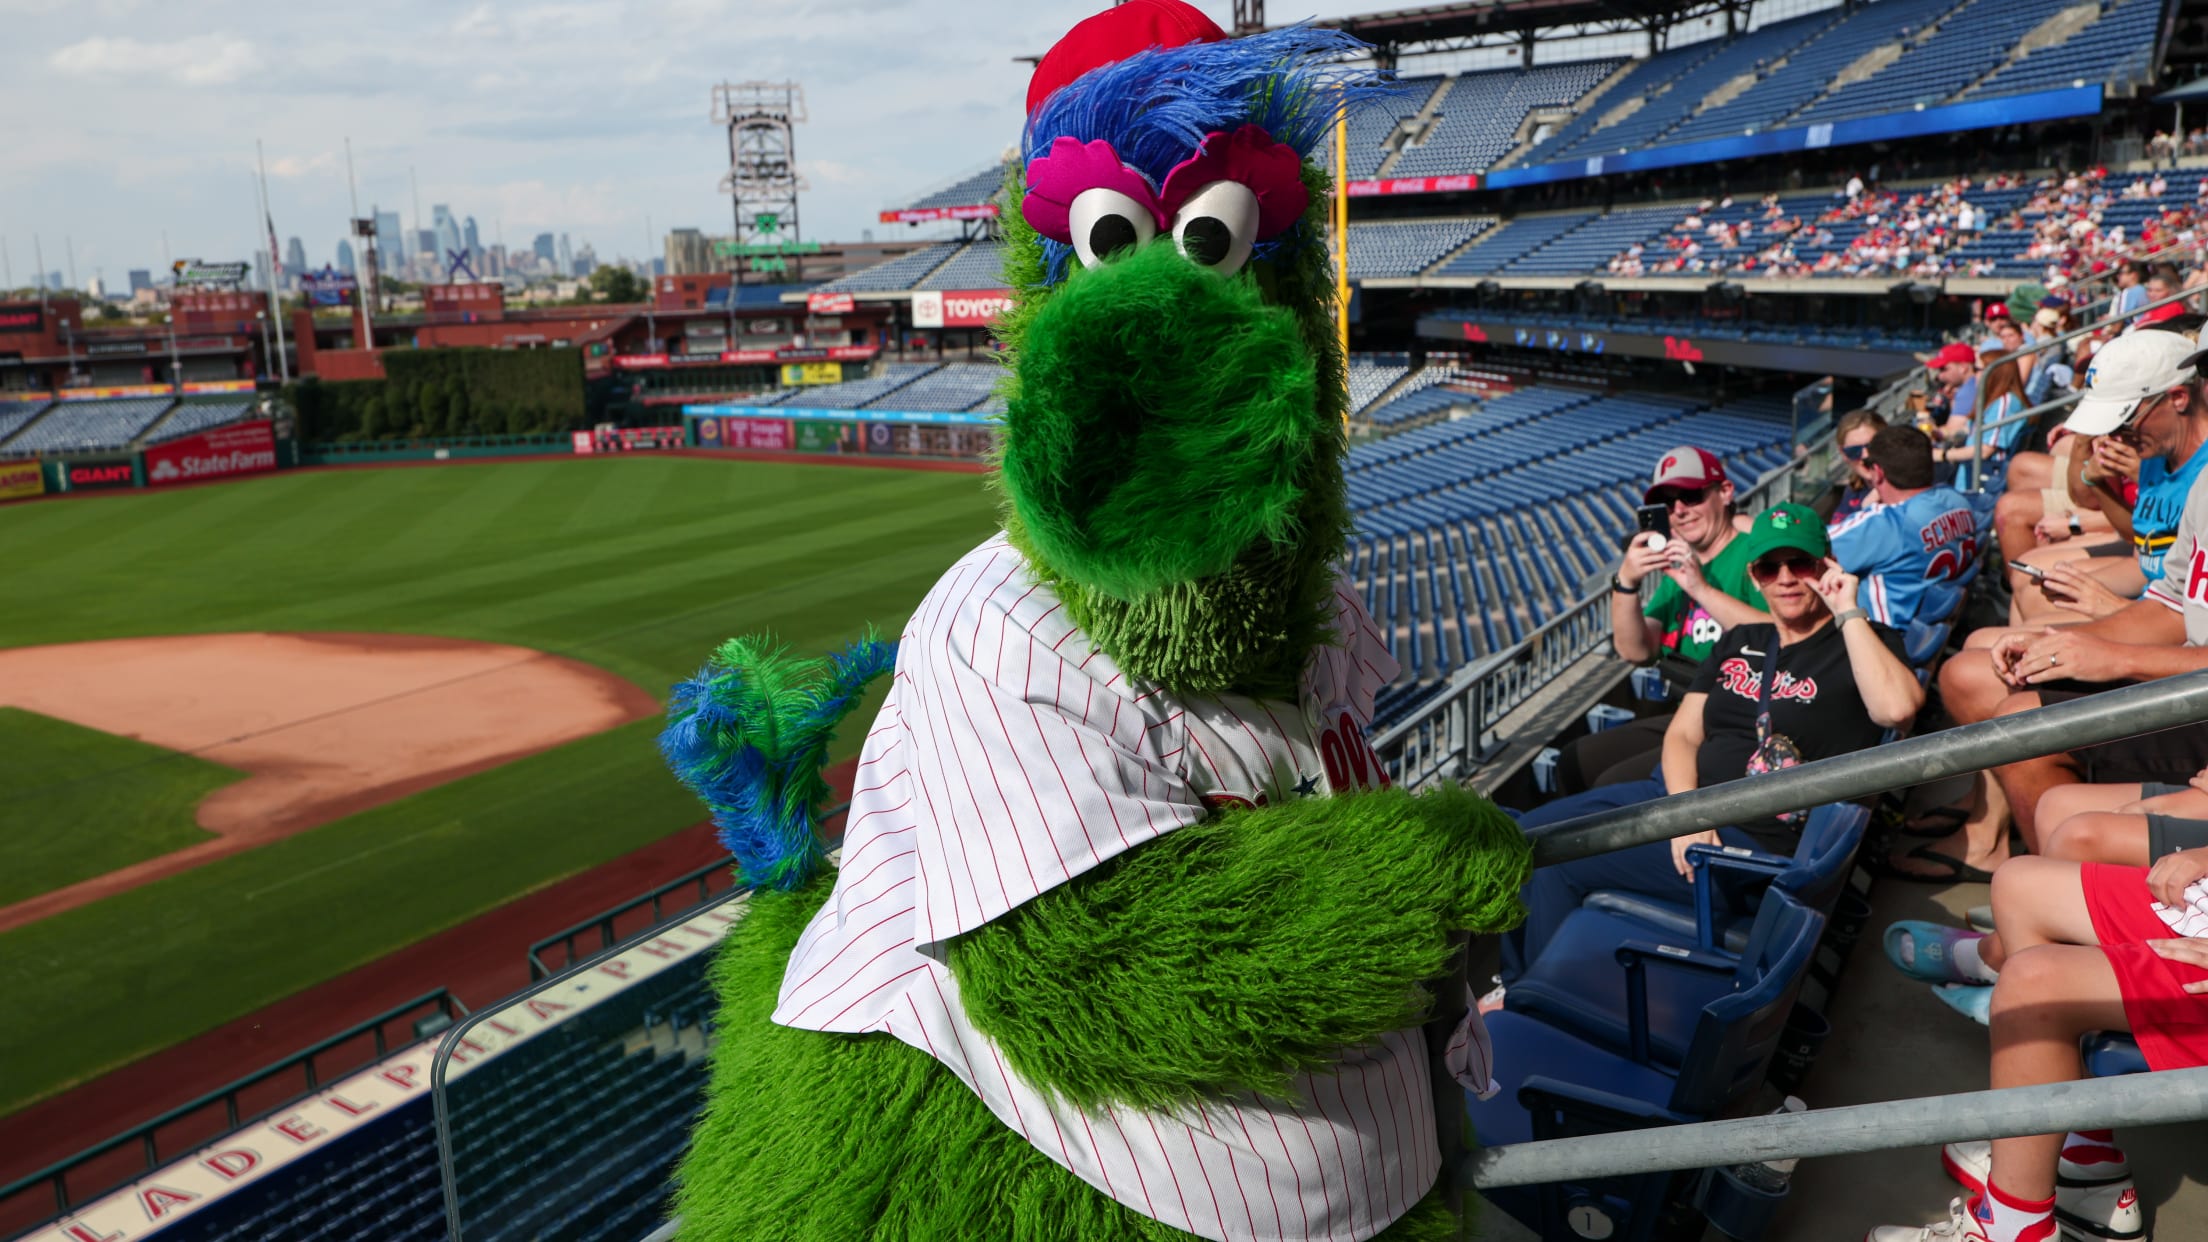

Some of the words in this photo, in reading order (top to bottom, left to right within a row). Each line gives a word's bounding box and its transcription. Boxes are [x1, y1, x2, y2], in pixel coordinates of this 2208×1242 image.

[752, 256, 786, 272] Park
[70, 464, 132, 484] GIANT
[1660, 456, 1677, 478] P
[1584, 1212, 1592, 1232] 1
